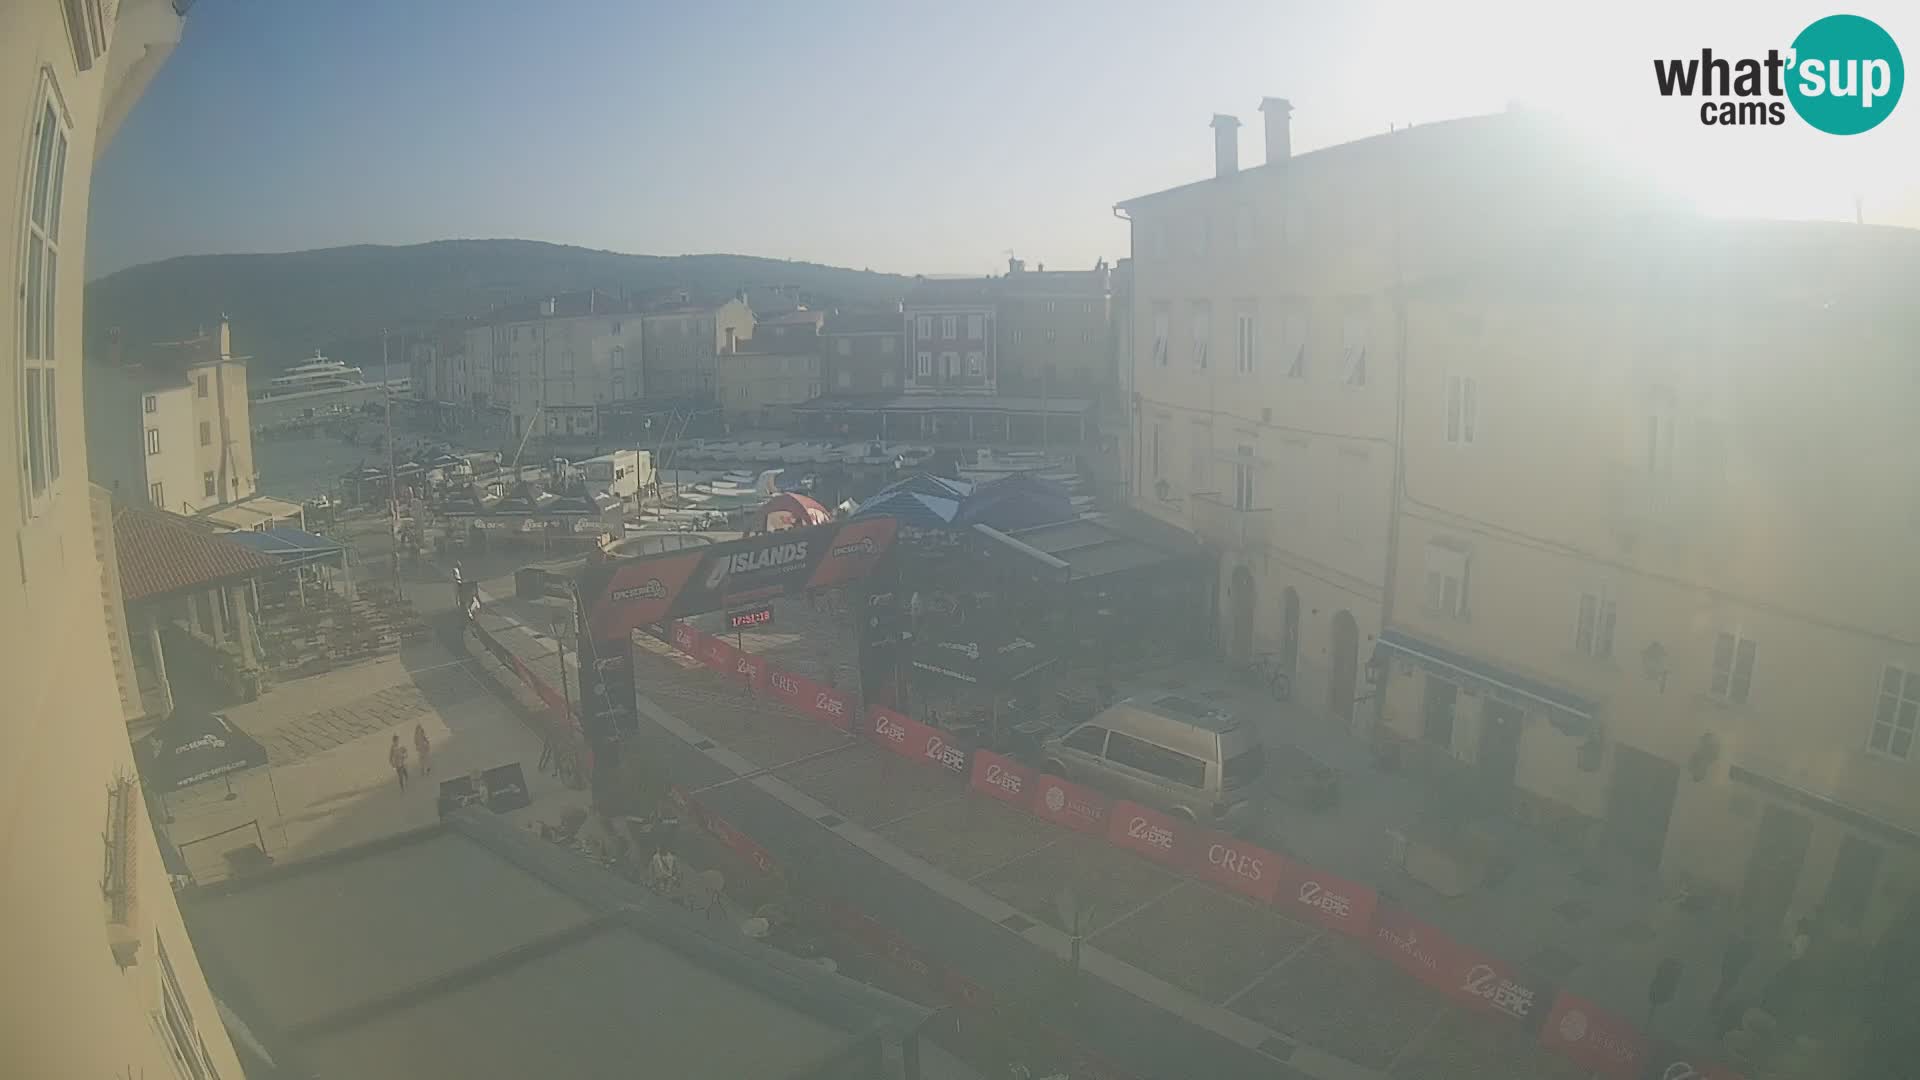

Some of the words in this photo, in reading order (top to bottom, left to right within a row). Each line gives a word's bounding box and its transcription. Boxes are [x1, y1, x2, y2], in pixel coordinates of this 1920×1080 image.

[729, 541, 808, 573] ISLANDS
[772, 672, 799, 694] CRES
[1148, 832, 1173, 848] EPIC
[1208, 844, 1264, 880] CRES
[1321, 896, 1350, 916] EPIC
[1494, 987, 1529, 1015] EPIC
